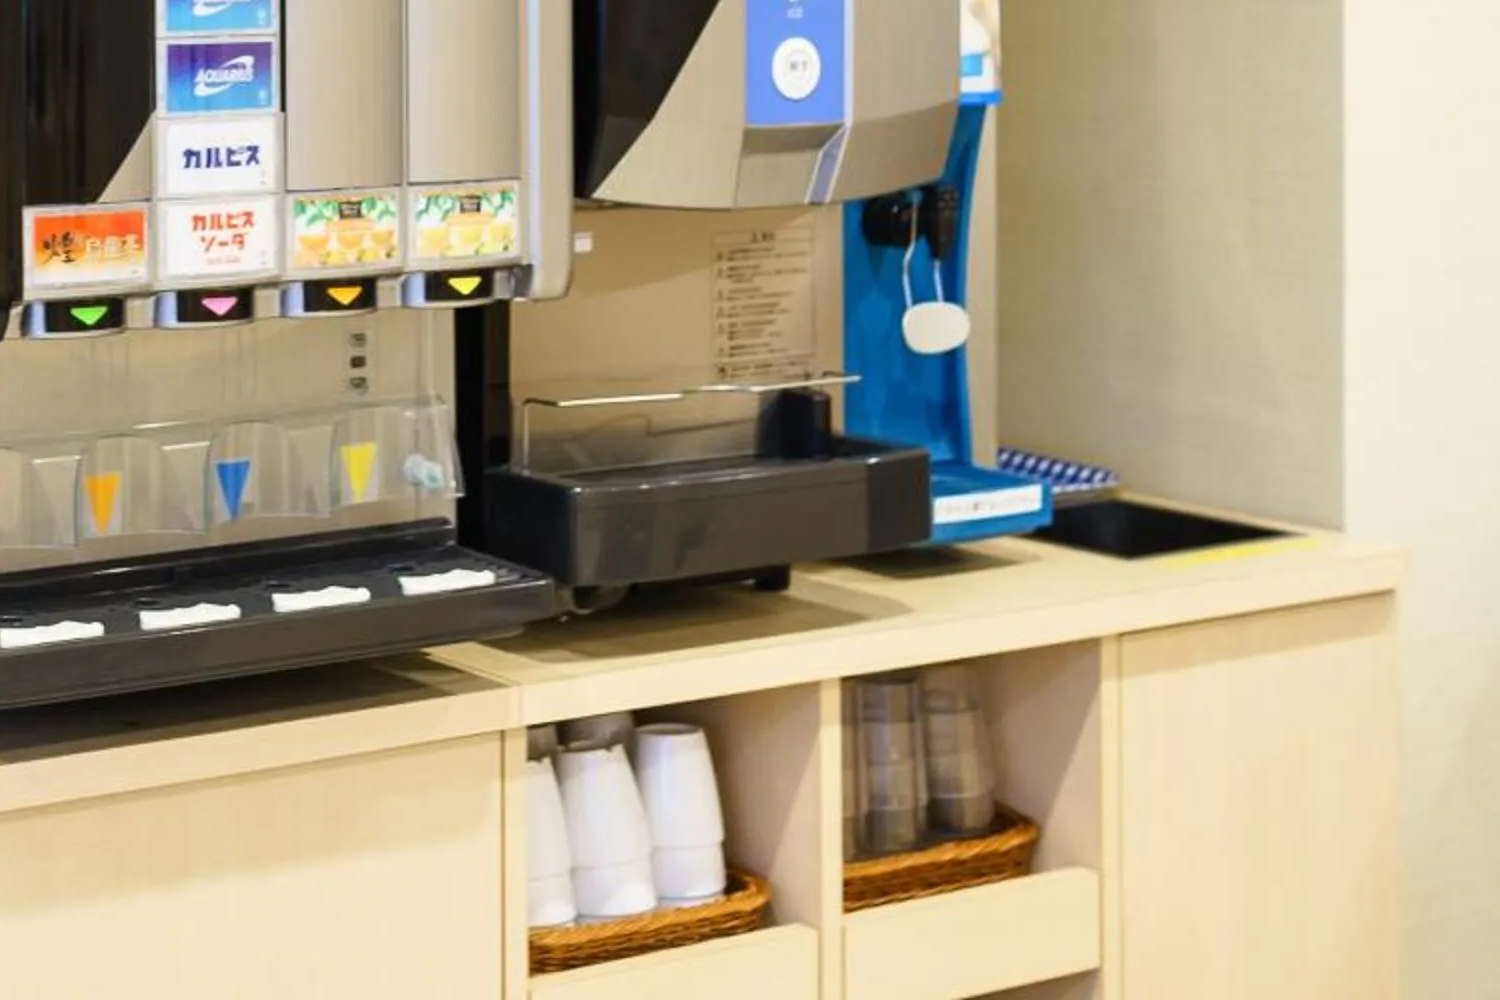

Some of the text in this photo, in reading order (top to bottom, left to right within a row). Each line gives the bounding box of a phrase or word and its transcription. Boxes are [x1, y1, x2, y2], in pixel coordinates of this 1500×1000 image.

[183, 145, 260, 169] カルピス
[191, 211, 255, 231] カルピス
[200, 231, 248, 253] ソーダ
